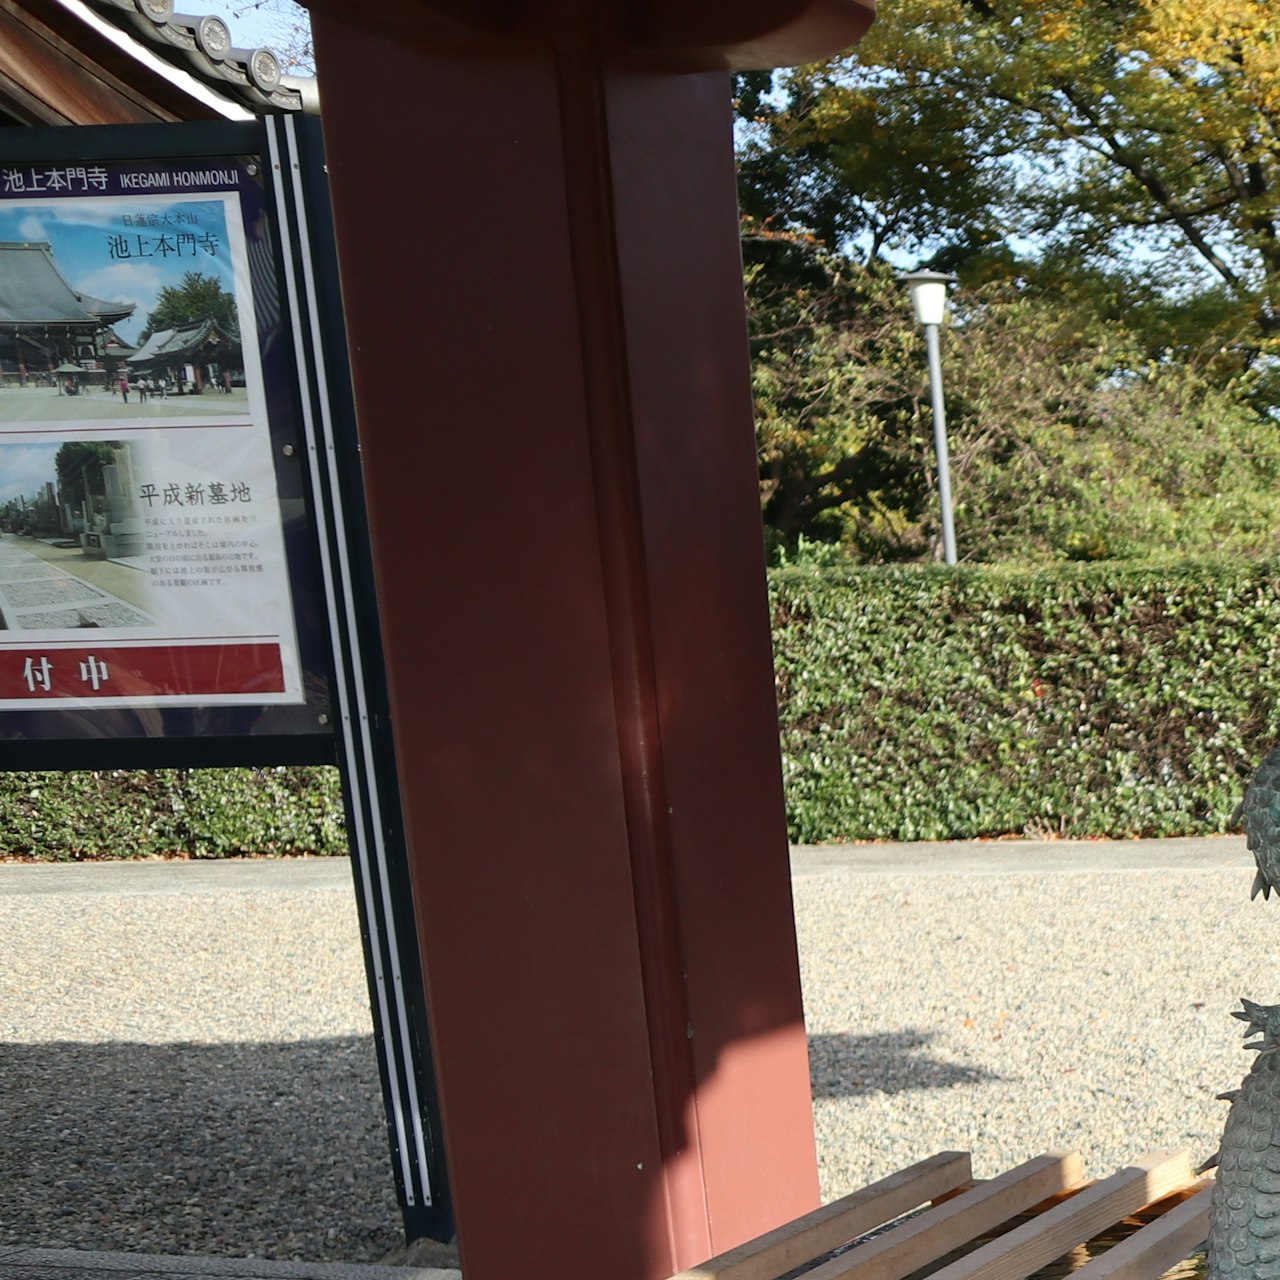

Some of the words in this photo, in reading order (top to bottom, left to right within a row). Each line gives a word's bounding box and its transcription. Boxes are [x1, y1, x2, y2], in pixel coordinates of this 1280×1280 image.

[3, 166, 109, 193] 池上本門寺
[119, 171, 171, 189] IKEGAMI
[174, 169, 239, 187] HONMONJI
[121, 212, 199, 229] 日蓮宗大本山
[106, 231, 220, 260] 池上本門寺
[138, 481, 252, 508] 平成新墓地
